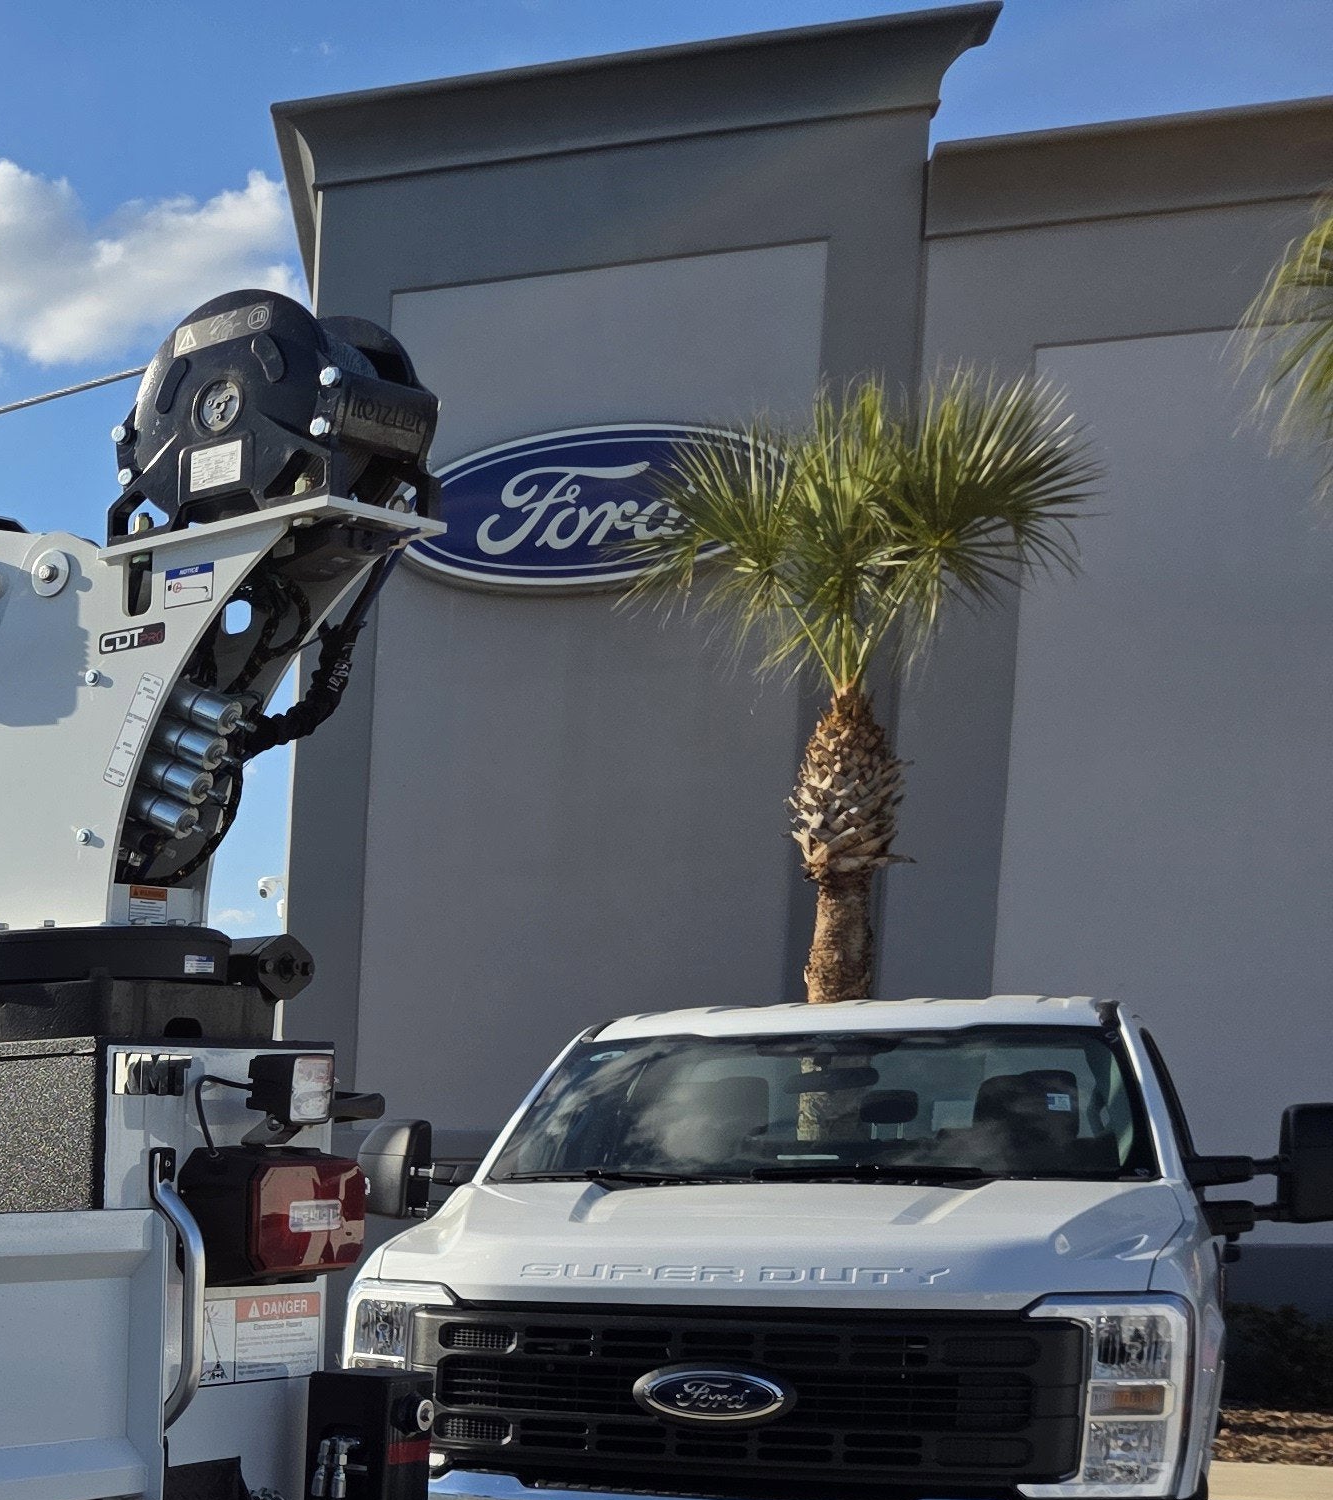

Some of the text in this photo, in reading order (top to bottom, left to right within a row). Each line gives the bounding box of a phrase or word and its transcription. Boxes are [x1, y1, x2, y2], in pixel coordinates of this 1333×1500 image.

[114, 1052, 193, 1096] KMT
[519, 1262, 952, 1285] SUPER DUTY
[262, 1299, 308, 1316] DANGER
[676, 1380, 750, 1408] Ford
